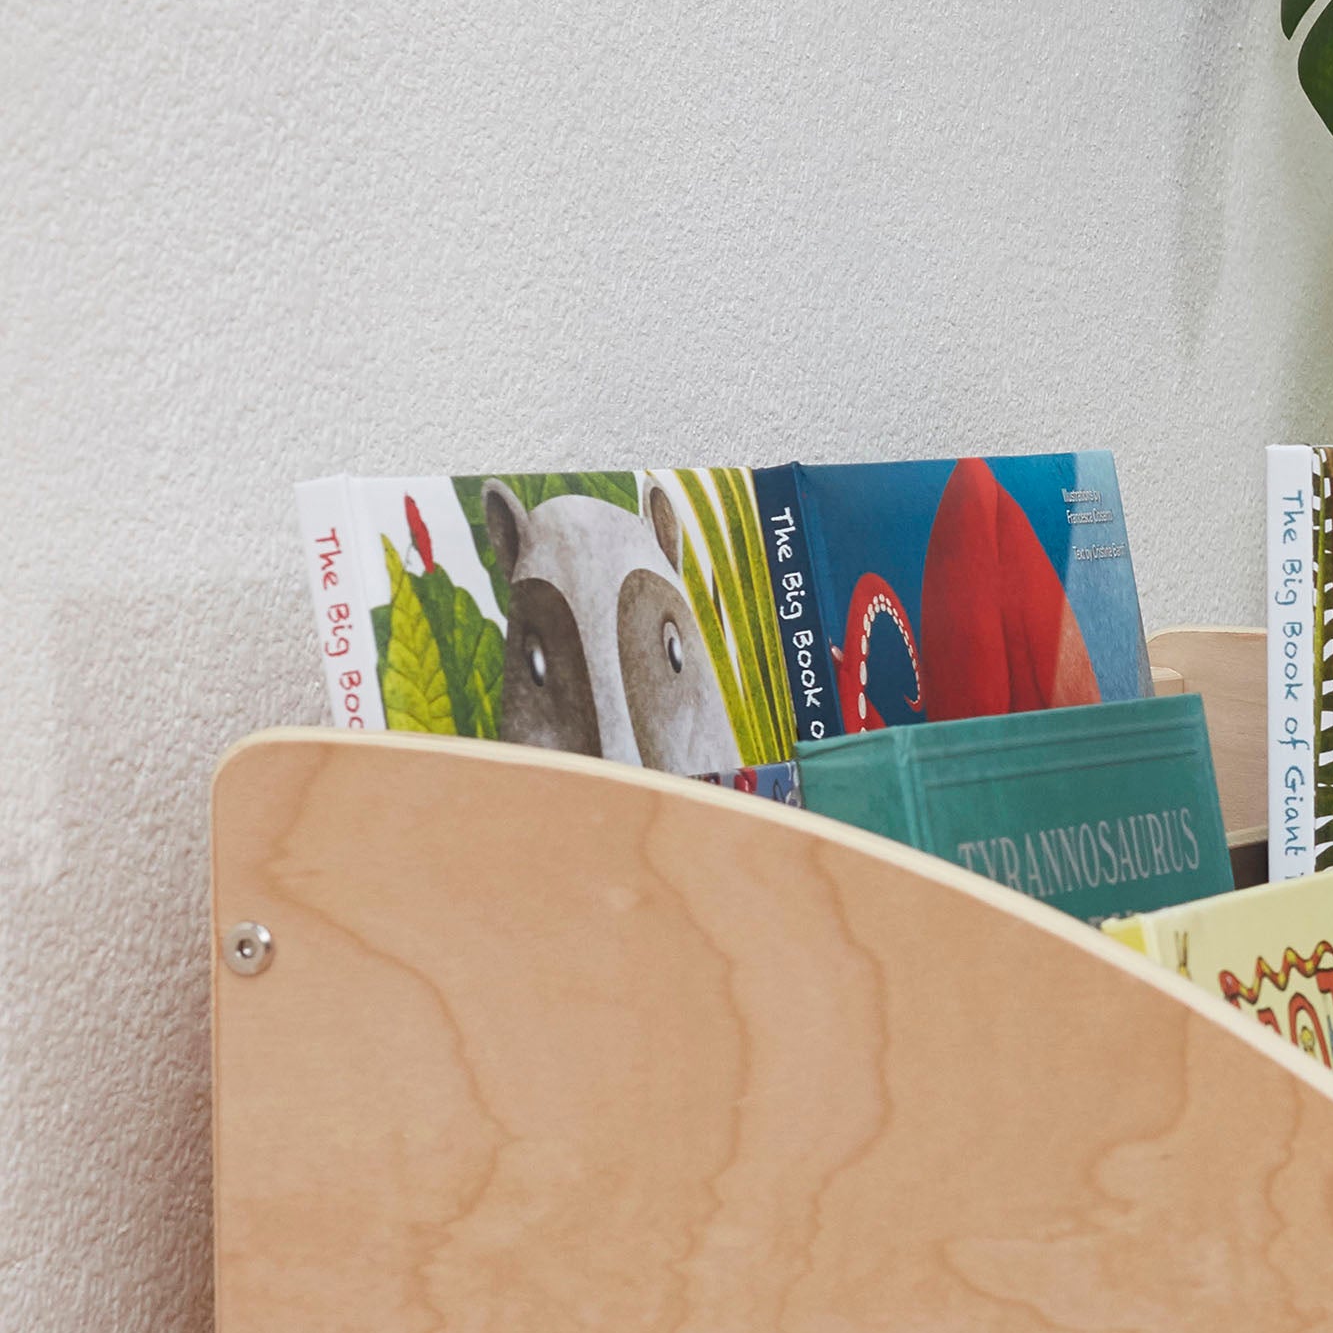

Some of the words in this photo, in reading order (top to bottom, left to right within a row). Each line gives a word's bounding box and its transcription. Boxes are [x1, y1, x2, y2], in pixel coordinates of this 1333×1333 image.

[770, 506, 797, 563] The
[1282, 489, 1305, 545] The
[315, 527, 342, 590] The
[1274, 559, 1303, 606] Big
[779, 571, 806, 620] Big
[324, 602, 352, 658] Big
[792, 629, 823, 708] Book
[1282, 621, 1303, 701] Book
[1277, 716, 1310, 751] of
[1284, 765, 1307, 856] Giant
[957, 806, 1199, 899] TYRANNOSAURUS
